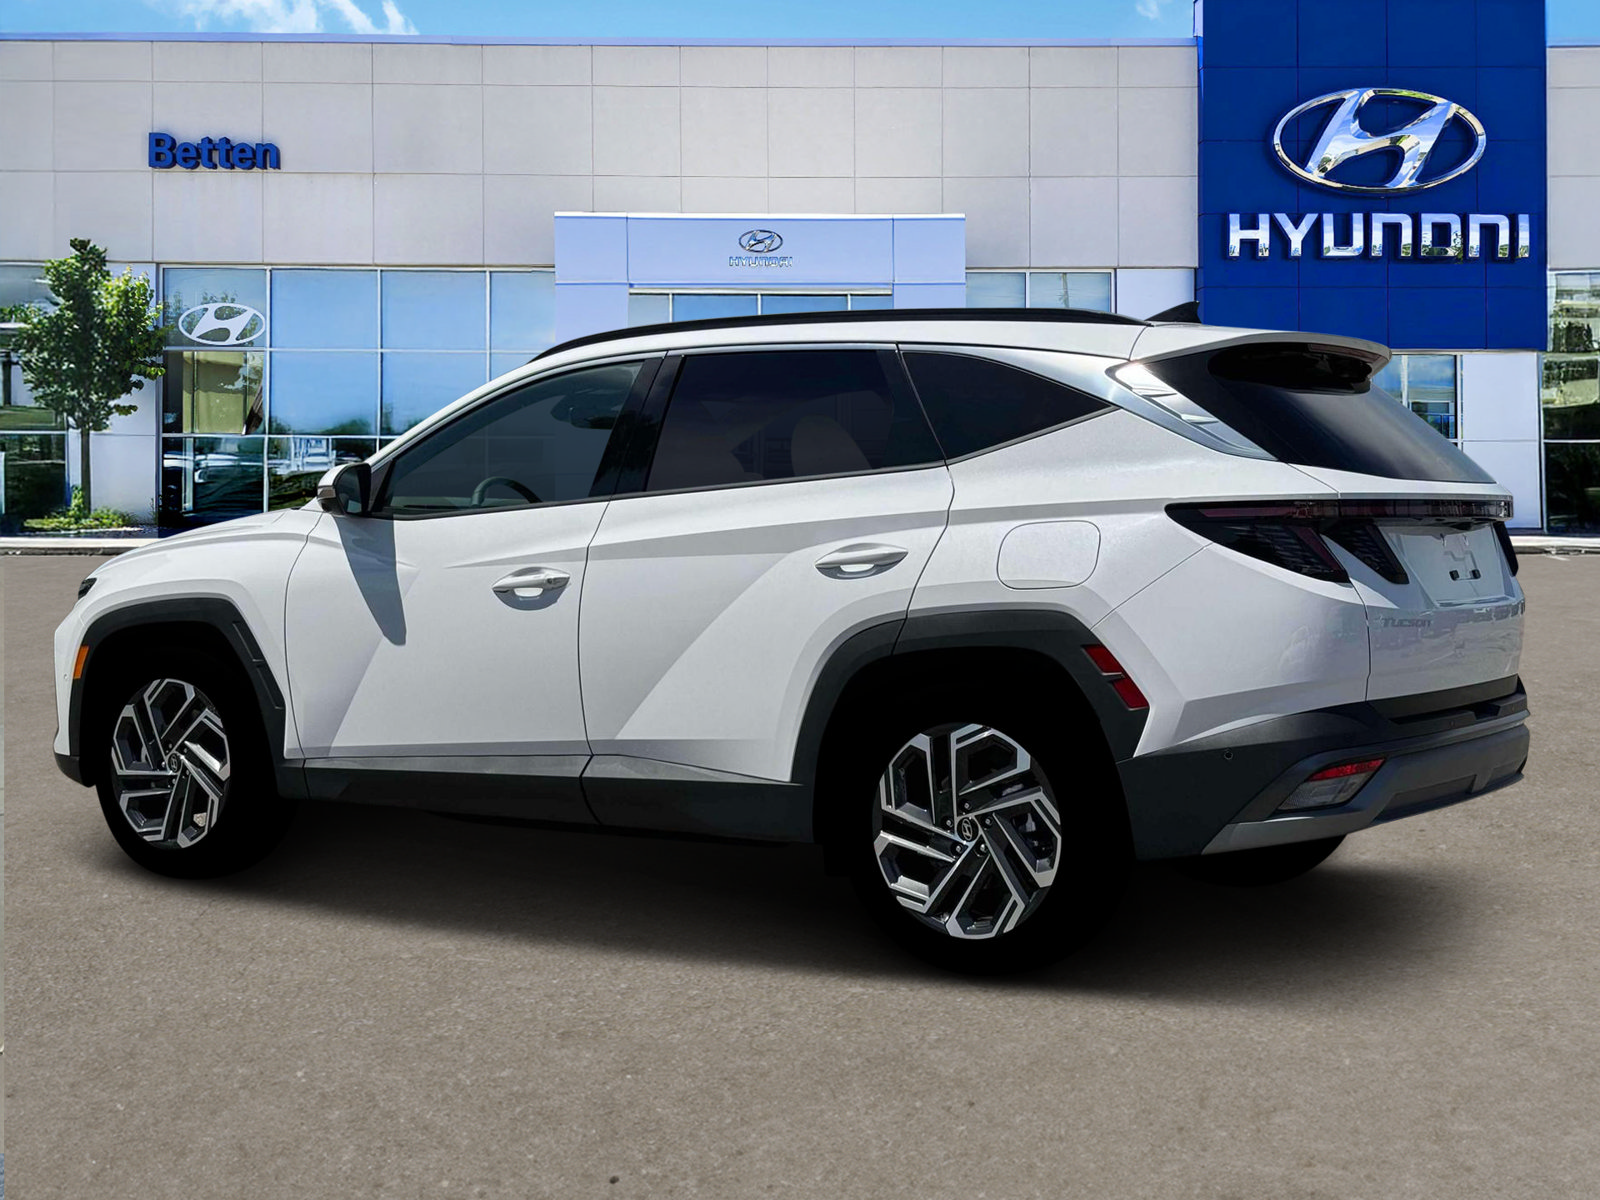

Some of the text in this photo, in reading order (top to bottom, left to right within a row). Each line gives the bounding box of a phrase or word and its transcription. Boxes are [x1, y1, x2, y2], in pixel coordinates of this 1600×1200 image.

[148, 132, 281, 170] Betten
[1227, 212, 1530, 258] HYUNDAI
[728, 256, 793, 267] HYUNDAI
